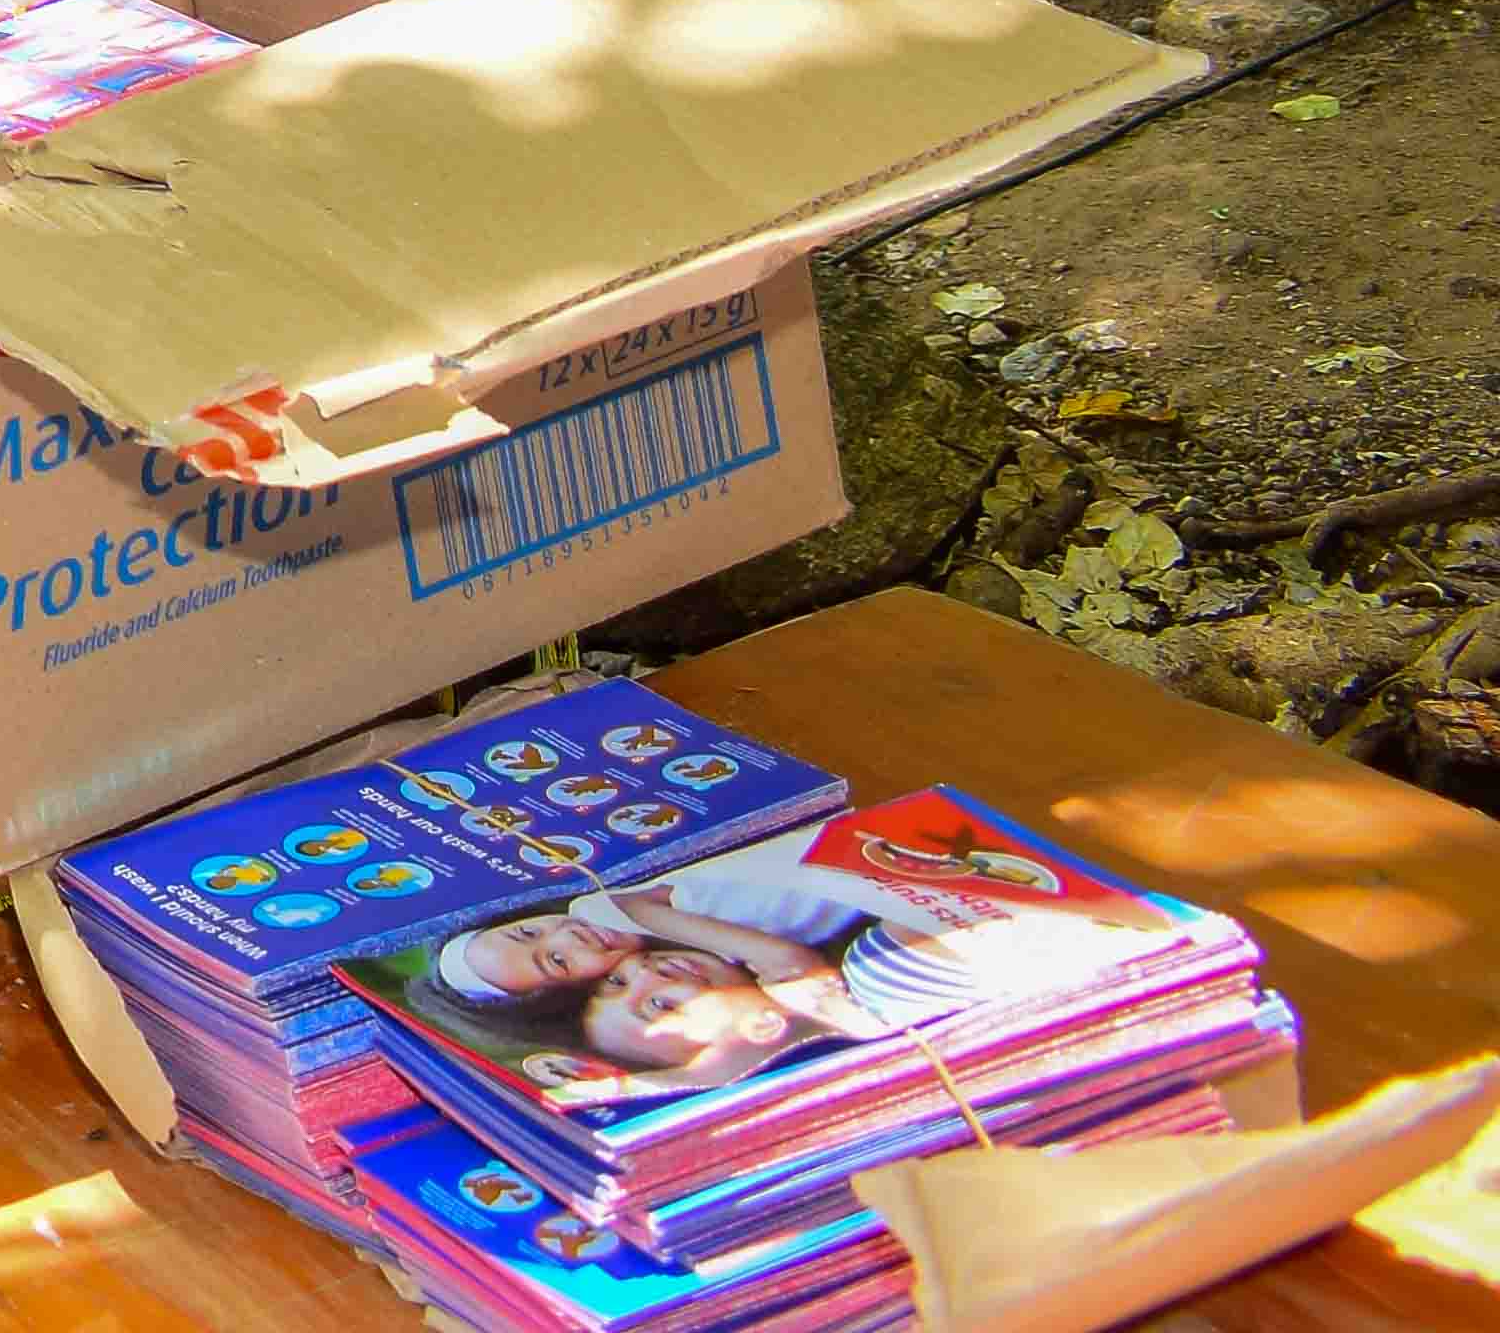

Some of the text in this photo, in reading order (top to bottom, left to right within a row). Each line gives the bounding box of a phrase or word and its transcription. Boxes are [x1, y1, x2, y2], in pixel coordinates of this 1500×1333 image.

[538, 356, 572, 393] 12
[579, 349, 596, 374] x
[611, 328, 648, 364] 24
[656, 319, 675, 344] x
[726, 293, 746, 329] g
[43, 533, 344, 673] Fluoride and Calcium Toothpaste
[358, 784, 414, 825] hands
[409, 812, 443, 837] our
[442, 831, 490, 864] wash
[109, 862, 160, 899] wash
[486, 854, 534, 884] Let's
[159, 896, 221, 942] should
[165, 882, 258, 937] my hands?
[216, 925, 270, 963] When
